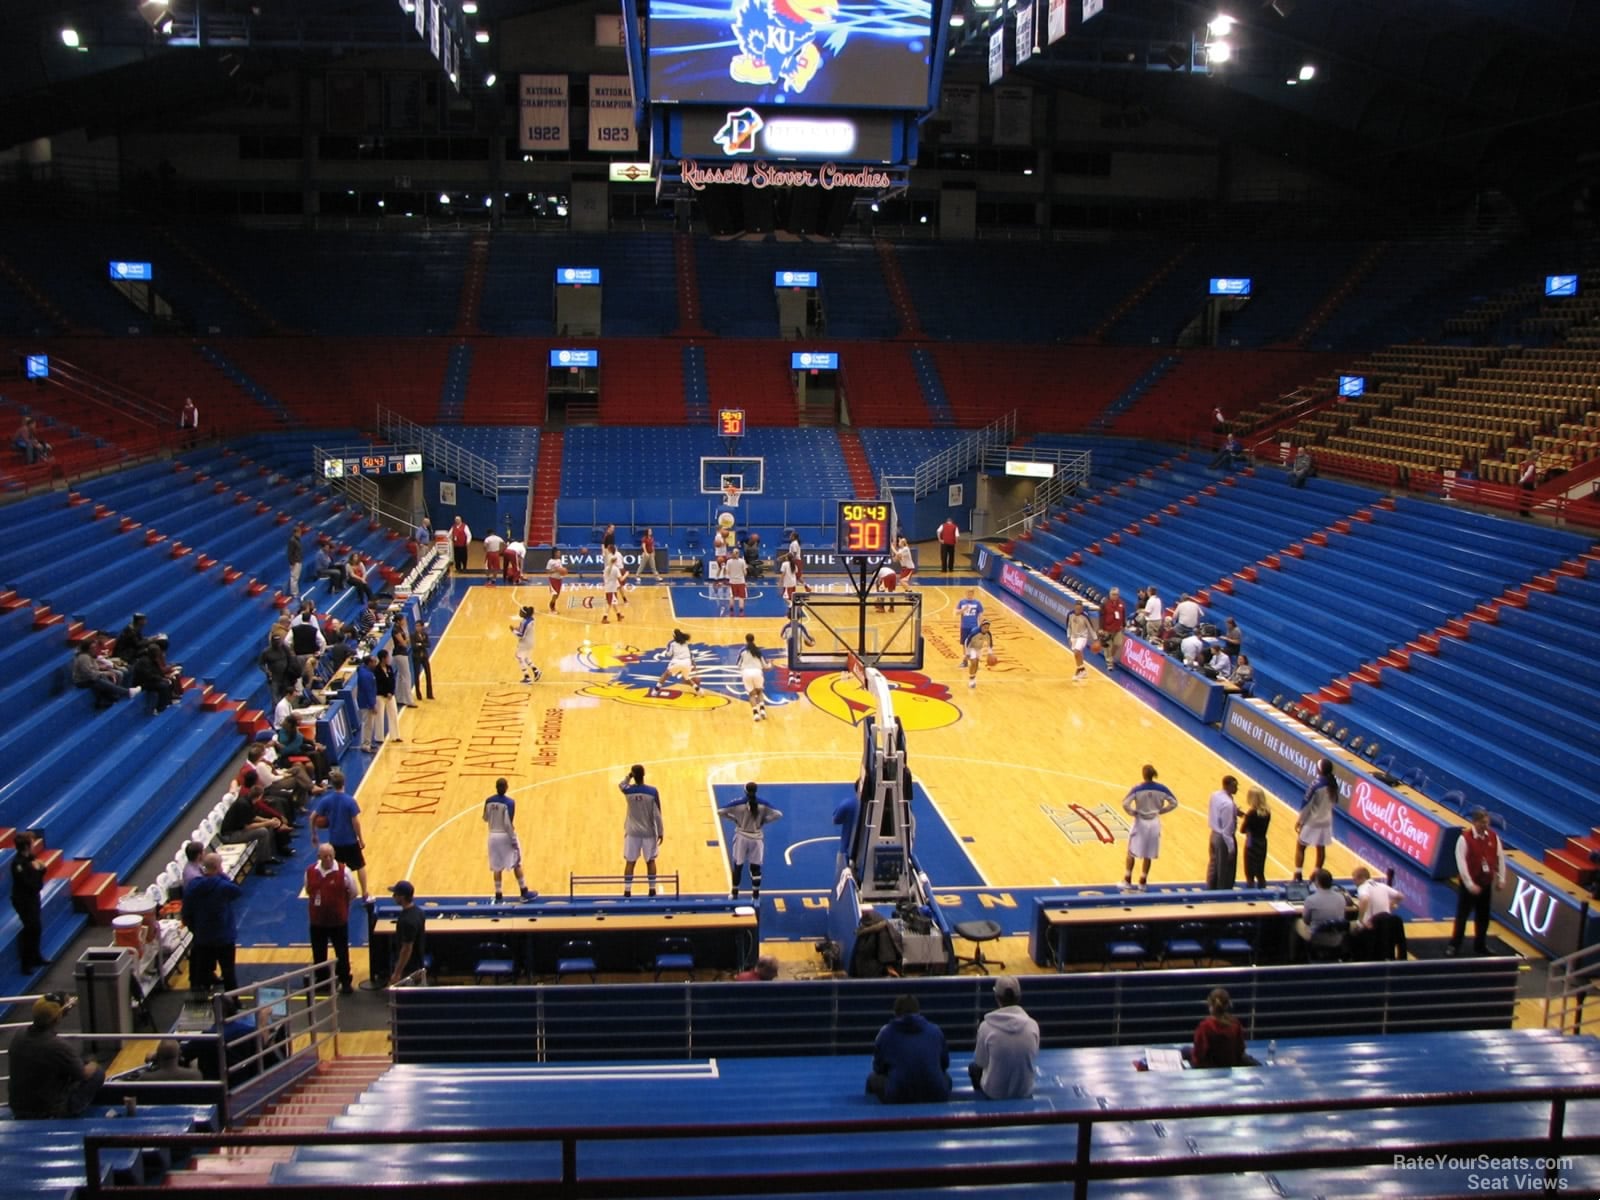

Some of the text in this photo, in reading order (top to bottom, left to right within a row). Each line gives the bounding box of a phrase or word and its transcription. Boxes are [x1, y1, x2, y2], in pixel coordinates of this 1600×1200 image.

[767, 25, 795, 54] KU
[526, 87, 562, 96] NATIONAL
[591, 100, 633, 109] CHAMPION
[528, 127, 561, 141] 1922
[597, 127, 630, 142] 1923
[678, 159, 749, 190] Russell
[752, 162, 817, 188] Stover
[819, 162, 890, 190] Candies
[724, 420, 740, 433] 30
[843, 506, 886, 521] 50:43
[849, 523, 880, 549] 30
[561, 554, 604, 565] EWAR
[803, 554, 836, 565] THE
[459, 691, 531, 777] JAYHAWKS
[1231, 711, 1252, 732] HOME
[1252, 725, 1264, 740] OF
[1263, 732, 1279, 753] THE
[1279, 742, 1307, 770] KANSAS
[530, 747, 558, 767] Allen
[377, 737, 462, 815] KANSAS
[1356, 781, 1430, 850] Russell Stover
[1373, 822, 1421, 860] CANDIES
[1508, 875, 1558, 937] KU
